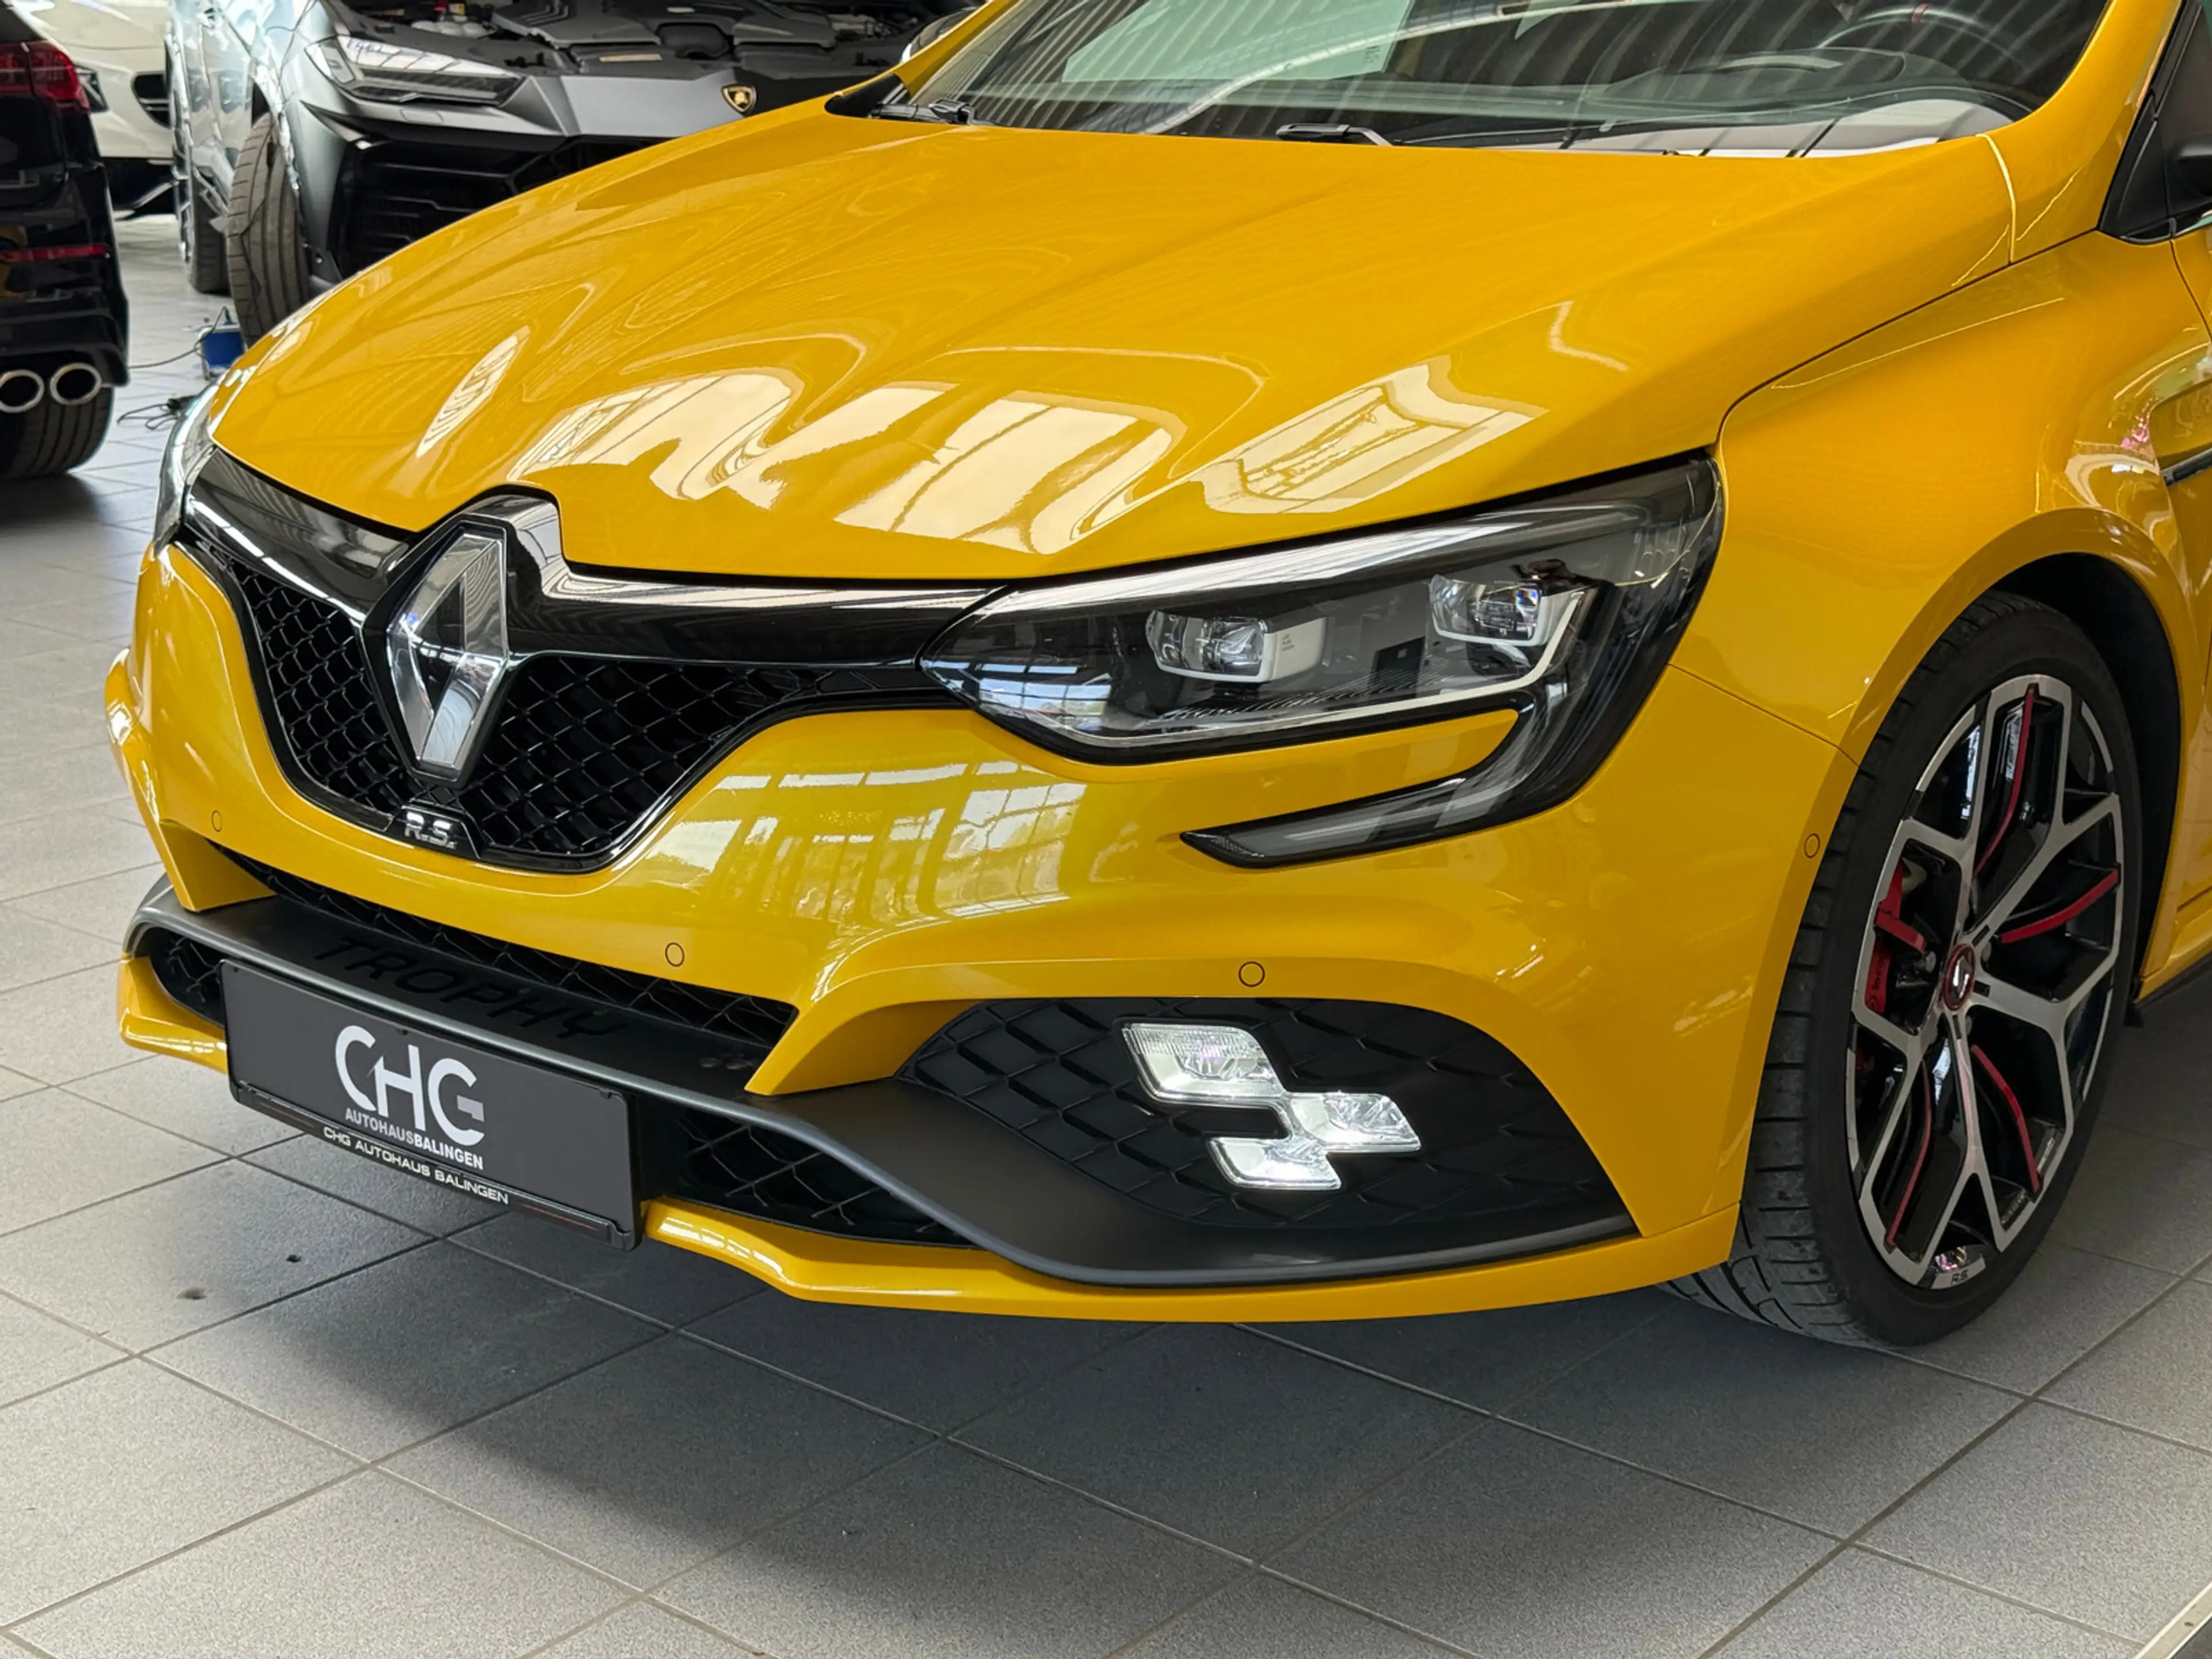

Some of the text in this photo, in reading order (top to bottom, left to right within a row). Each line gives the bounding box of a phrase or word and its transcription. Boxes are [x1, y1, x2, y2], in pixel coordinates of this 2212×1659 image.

[315, 937, 628, 1038] TROPHY
[335, 1025, 484, 1146] CHG
[323, 1126, 509, 1205] CHG AUTOHAUS BALINGEN
